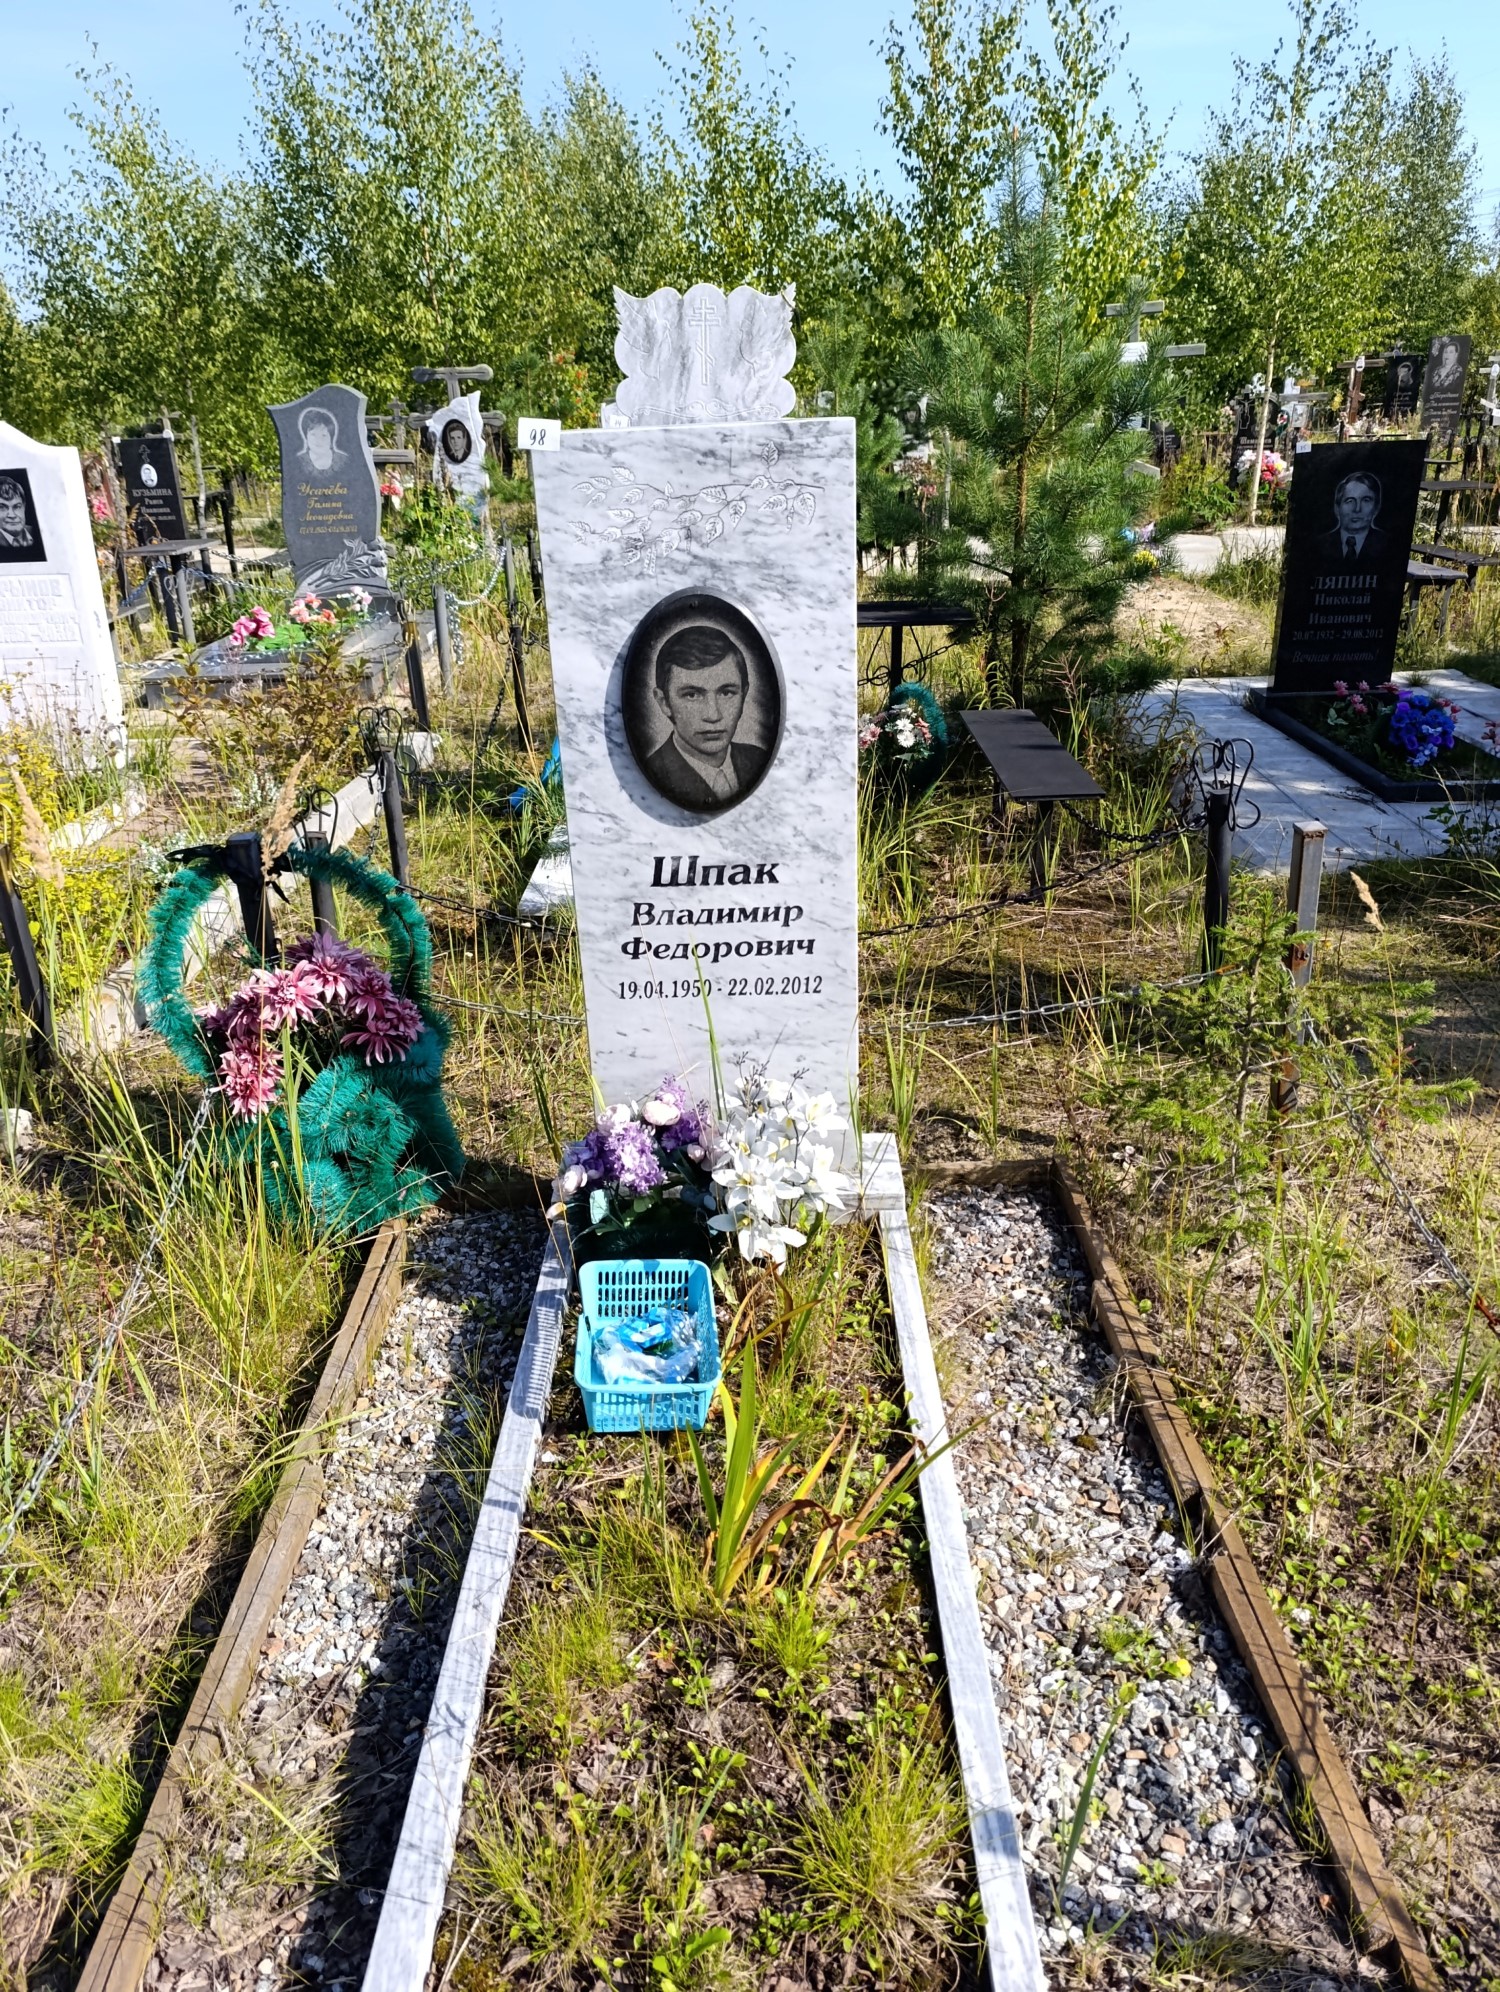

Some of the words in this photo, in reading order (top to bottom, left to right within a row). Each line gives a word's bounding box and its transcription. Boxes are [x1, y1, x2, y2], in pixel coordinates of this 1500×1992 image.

[529, 428, 547, 446] 98
[132, 488, 173, 497] КУЗЬМИНА
[297, 482, 348, 496] Усачёва
[306, 497, 342, 509] Галина
[299, 510, 354, 525] Леонидовна
[1310, 574, 1378, 590] ЛЯПИН
[1314, 592, 1371, 606] Николай
[1308, 612, 1372, 625] Иванович
[1341, 628, 1384, 640] 29.08.2012
[1291, 650, 1330, 664] Вечная
[650, 855, 780, 888] Шпак
[631, 902, 804, 928] Владимир
[621, 936, 816, 964] Федорович
[618, 979, 712, 1000] 19.04.1950
[727, 975, 823, 997] 22.02.2012
